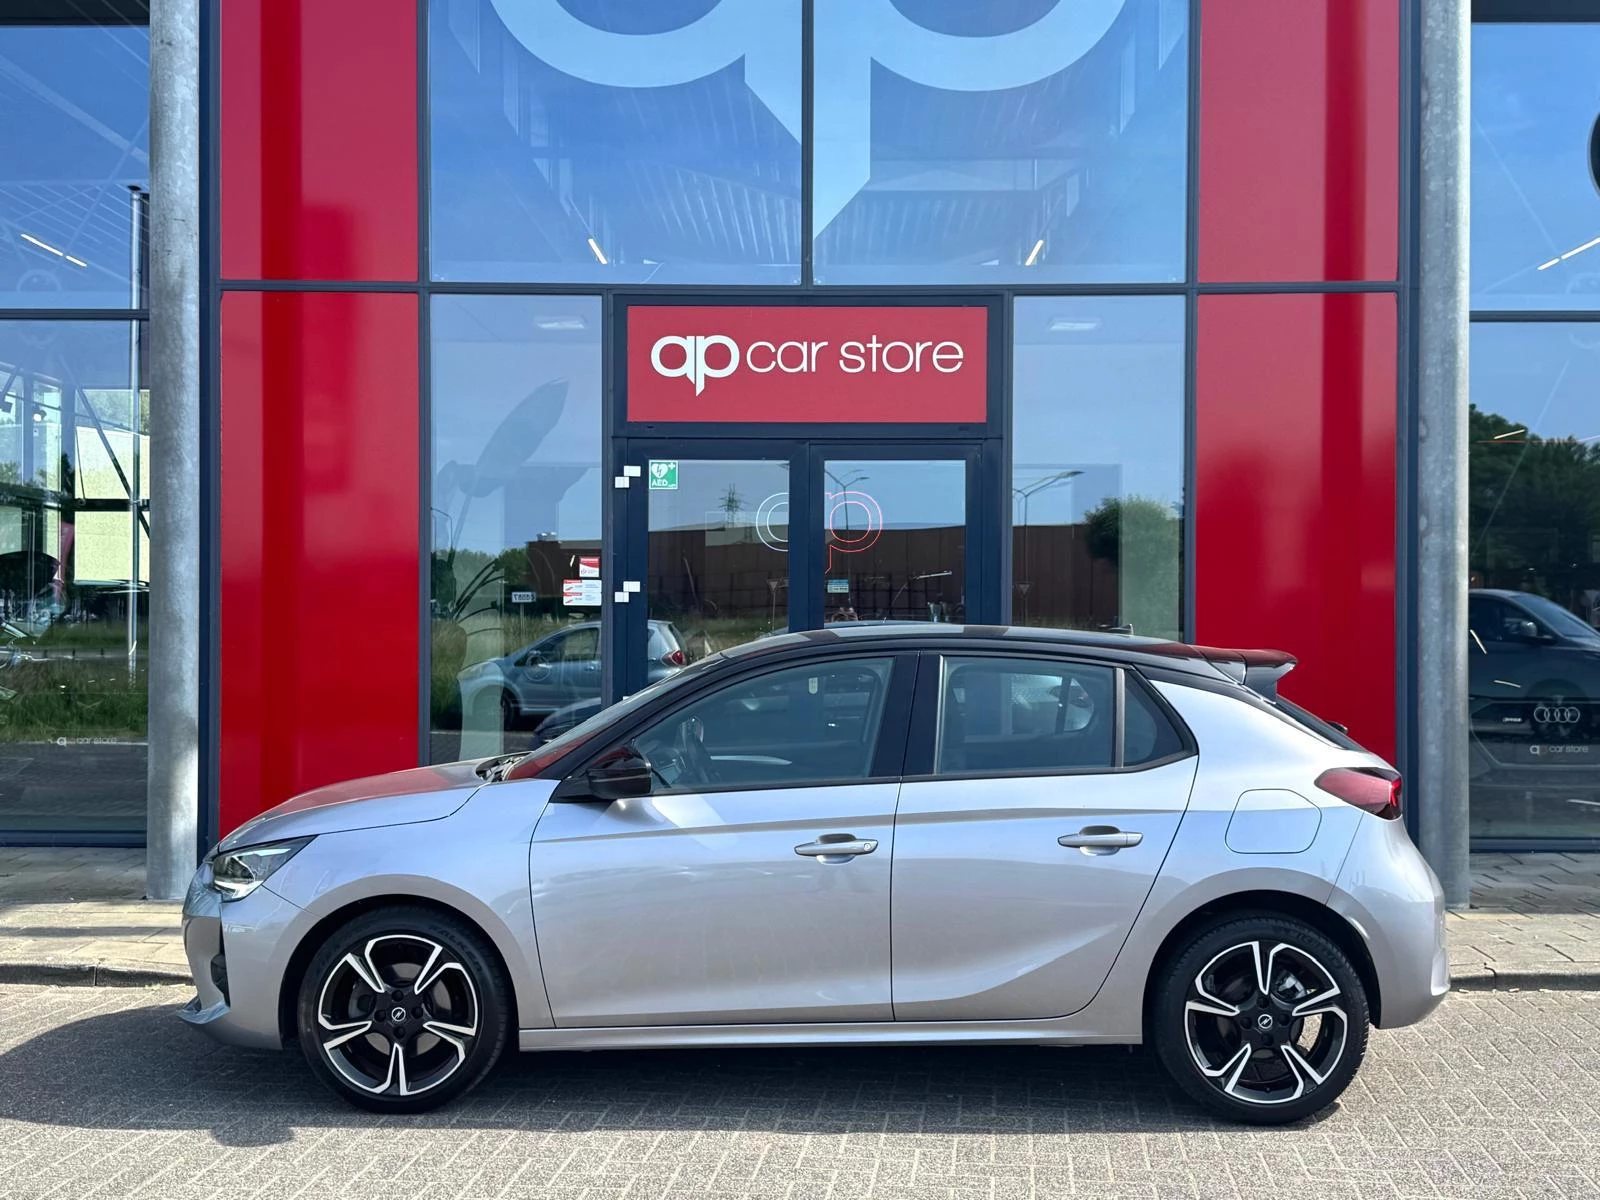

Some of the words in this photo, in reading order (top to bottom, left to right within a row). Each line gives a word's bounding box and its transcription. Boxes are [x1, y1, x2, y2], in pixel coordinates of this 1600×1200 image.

[650, 335, 740, 397] ap
[746, 340, 829, 373] car
[838, 335, 964, 373] store
[651, 479, 669, 487] AED
